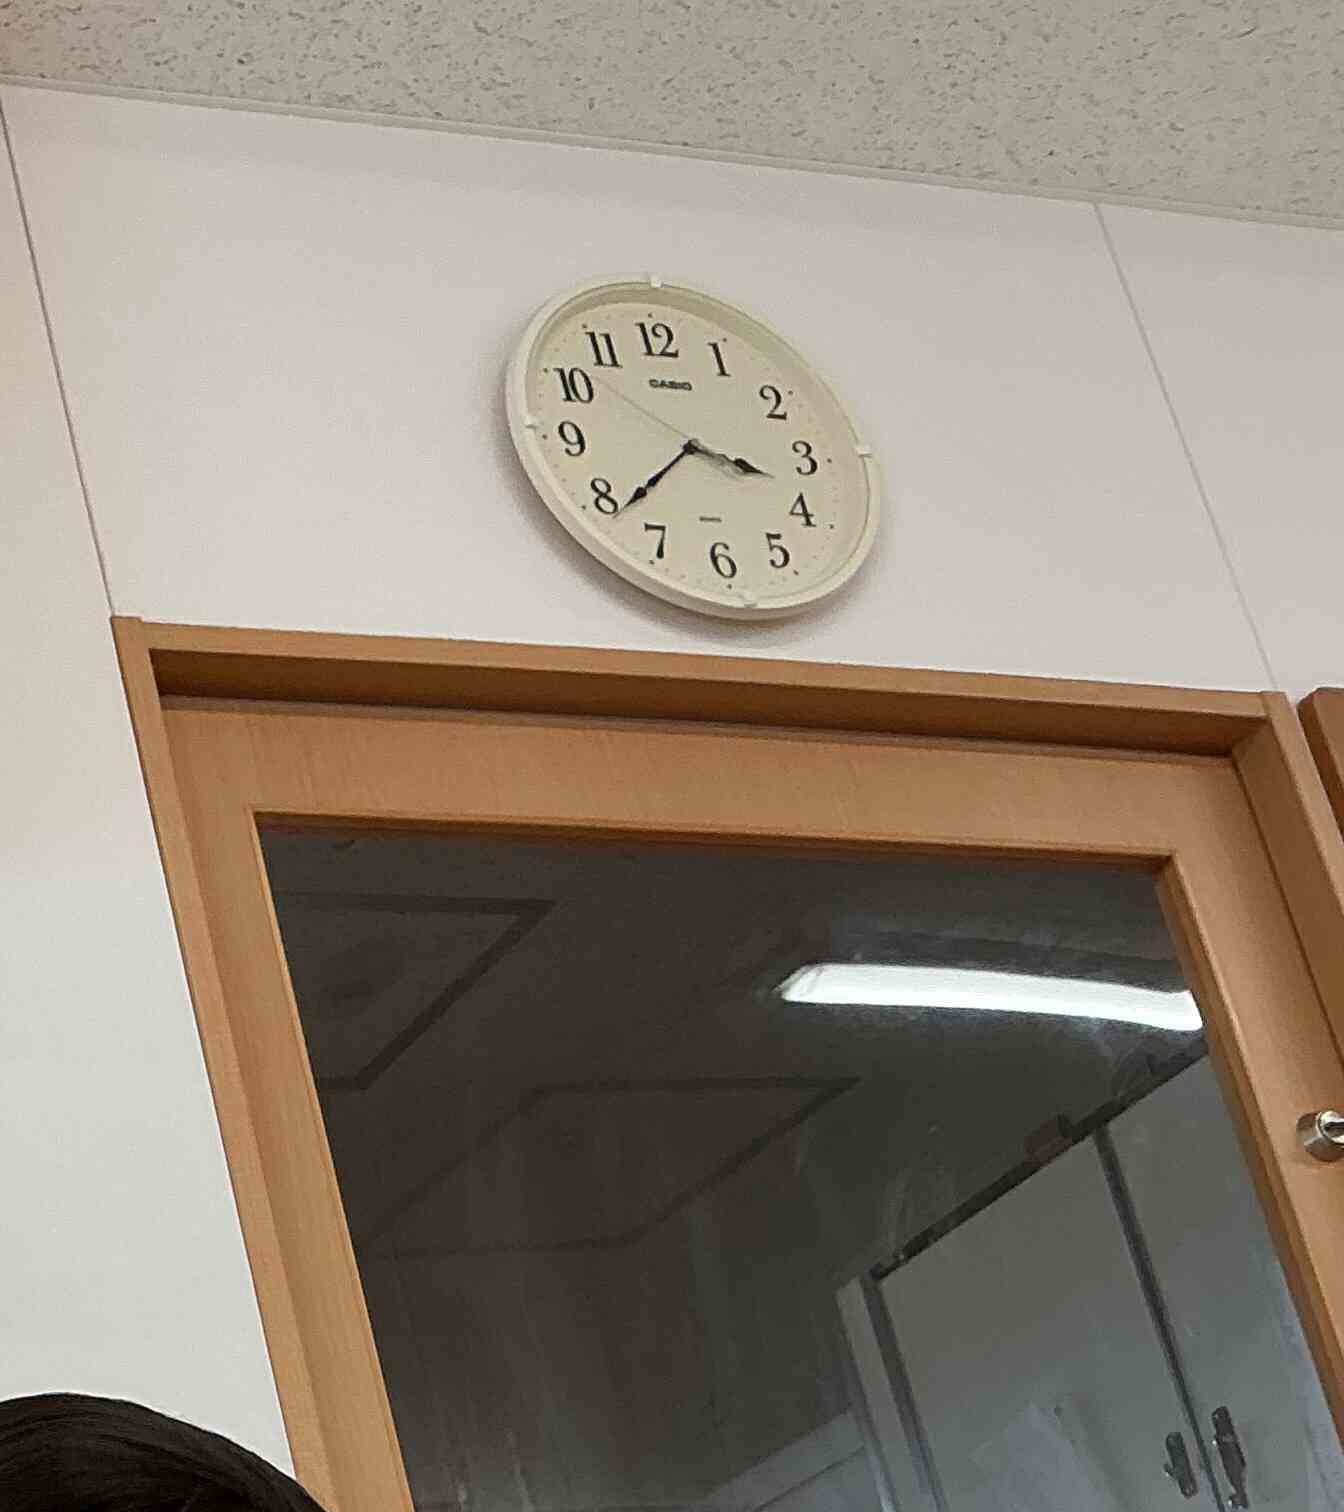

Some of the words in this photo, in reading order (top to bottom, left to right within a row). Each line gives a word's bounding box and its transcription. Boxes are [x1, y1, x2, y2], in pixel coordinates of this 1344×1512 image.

[586, 331, 623, 368] 11
[635, 322, 680, 358] 12
[708, 343, 731, 377] 1
[555, 367, 594, 404] 10
[648, 379, 692, 391] CASIO
[759, 385, 787, 420] 2
[557, 421, 586, 457] 9
[791, 440, 818, 475] 3
[590, 478, 618, 515] 8
[789, 493, 817, 528] 4
[644, 523, 666, 560] 7
[766, 533, 790, 568] 5
[709, 542, 737, 578] 6
